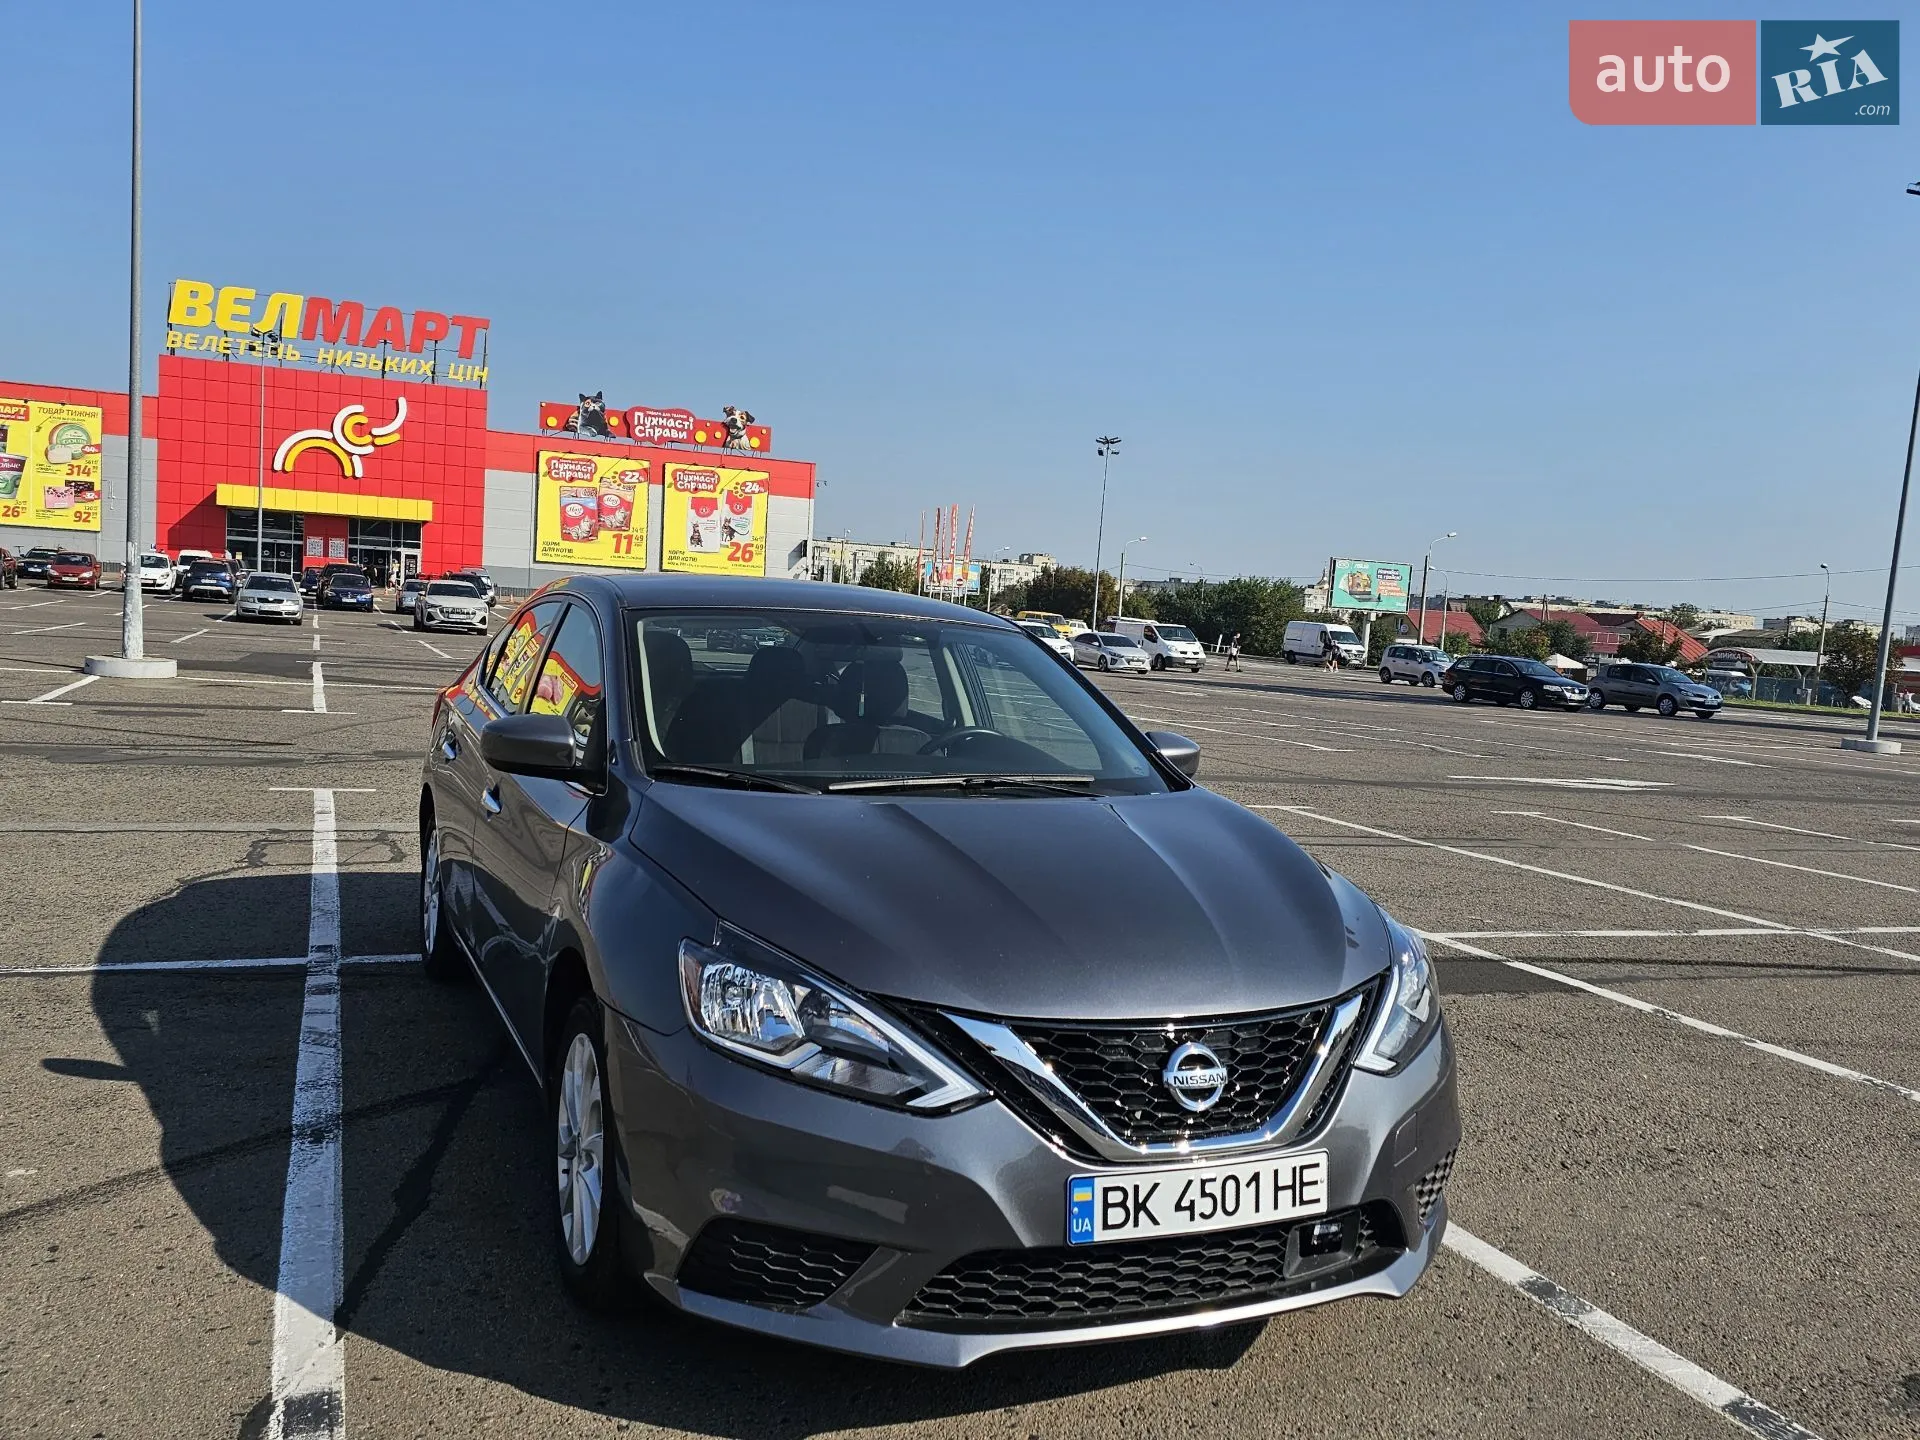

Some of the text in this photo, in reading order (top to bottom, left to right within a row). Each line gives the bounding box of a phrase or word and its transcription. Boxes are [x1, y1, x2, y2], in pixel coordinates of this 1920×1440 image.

[168, 279, 490, 360] ВЕЛМАРТ
[166, 330, 489, 383] ВЕЛЕТЕНЬ НИЗЬКИХ ЦІН
[37, 406, 65, 416] ТОВАР
[634, 411, 694, 430] Пухнасті
[634, 425, 688, 441] Справи
[66, 464, 91, 477] 314
[551, 459, 596, 474] Пухнасті
[551, 470, 591, 481] Справи
[676, 471, 719, 484] Пухнасті
[677, 480, 714, 491] Справи
[2, 505, 20, 517] 26
[73, 510, 91, 523] 92
[612, 533, 633, 554] 11
[727, 541, 754, 563] 26
[1173, 1073, 1226, 1087] NISSAN
[1102, 1162, 1321, 1231] BK 4501 HE
[1073, 1218, 1091, 1233] UA
